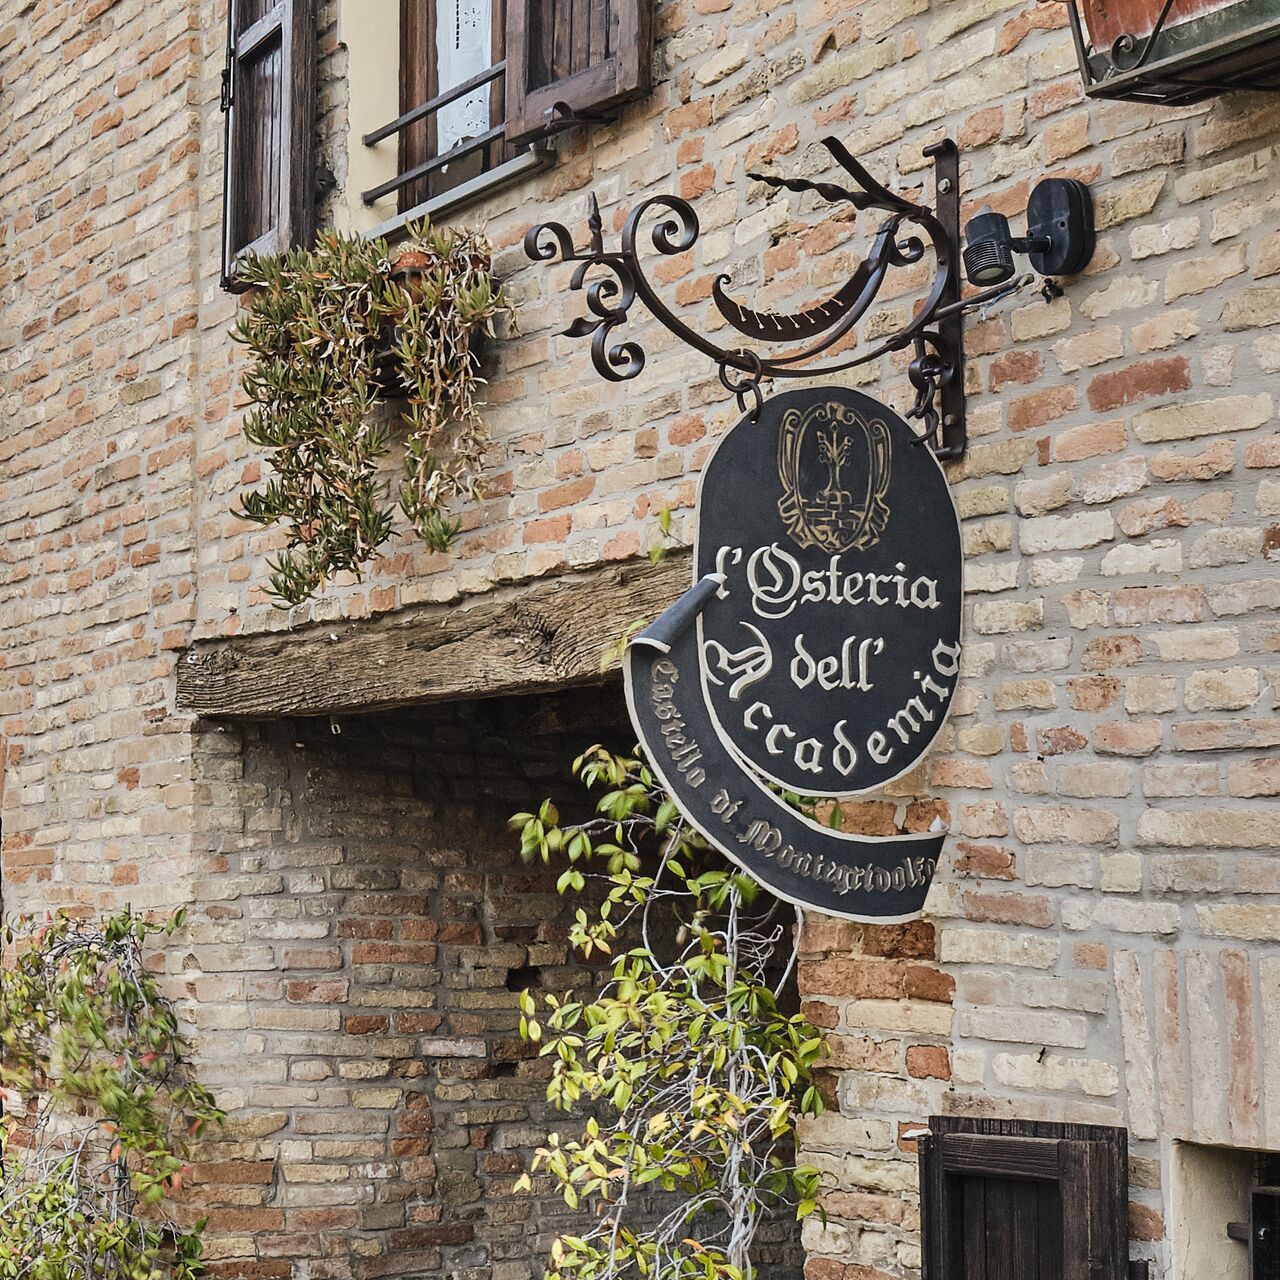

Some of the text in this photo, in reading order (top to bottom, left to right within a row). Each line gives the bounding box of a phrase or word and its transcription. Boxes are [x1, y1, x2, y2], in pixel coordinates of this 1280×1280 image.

[715, 542, 942, 619] l'Osteria
[703, 621, 962, 776] Accademia
[790, 633, 885, 692] dell'
[650, 658, 706, 789] Castello
[709, 788, 743, 823] di
